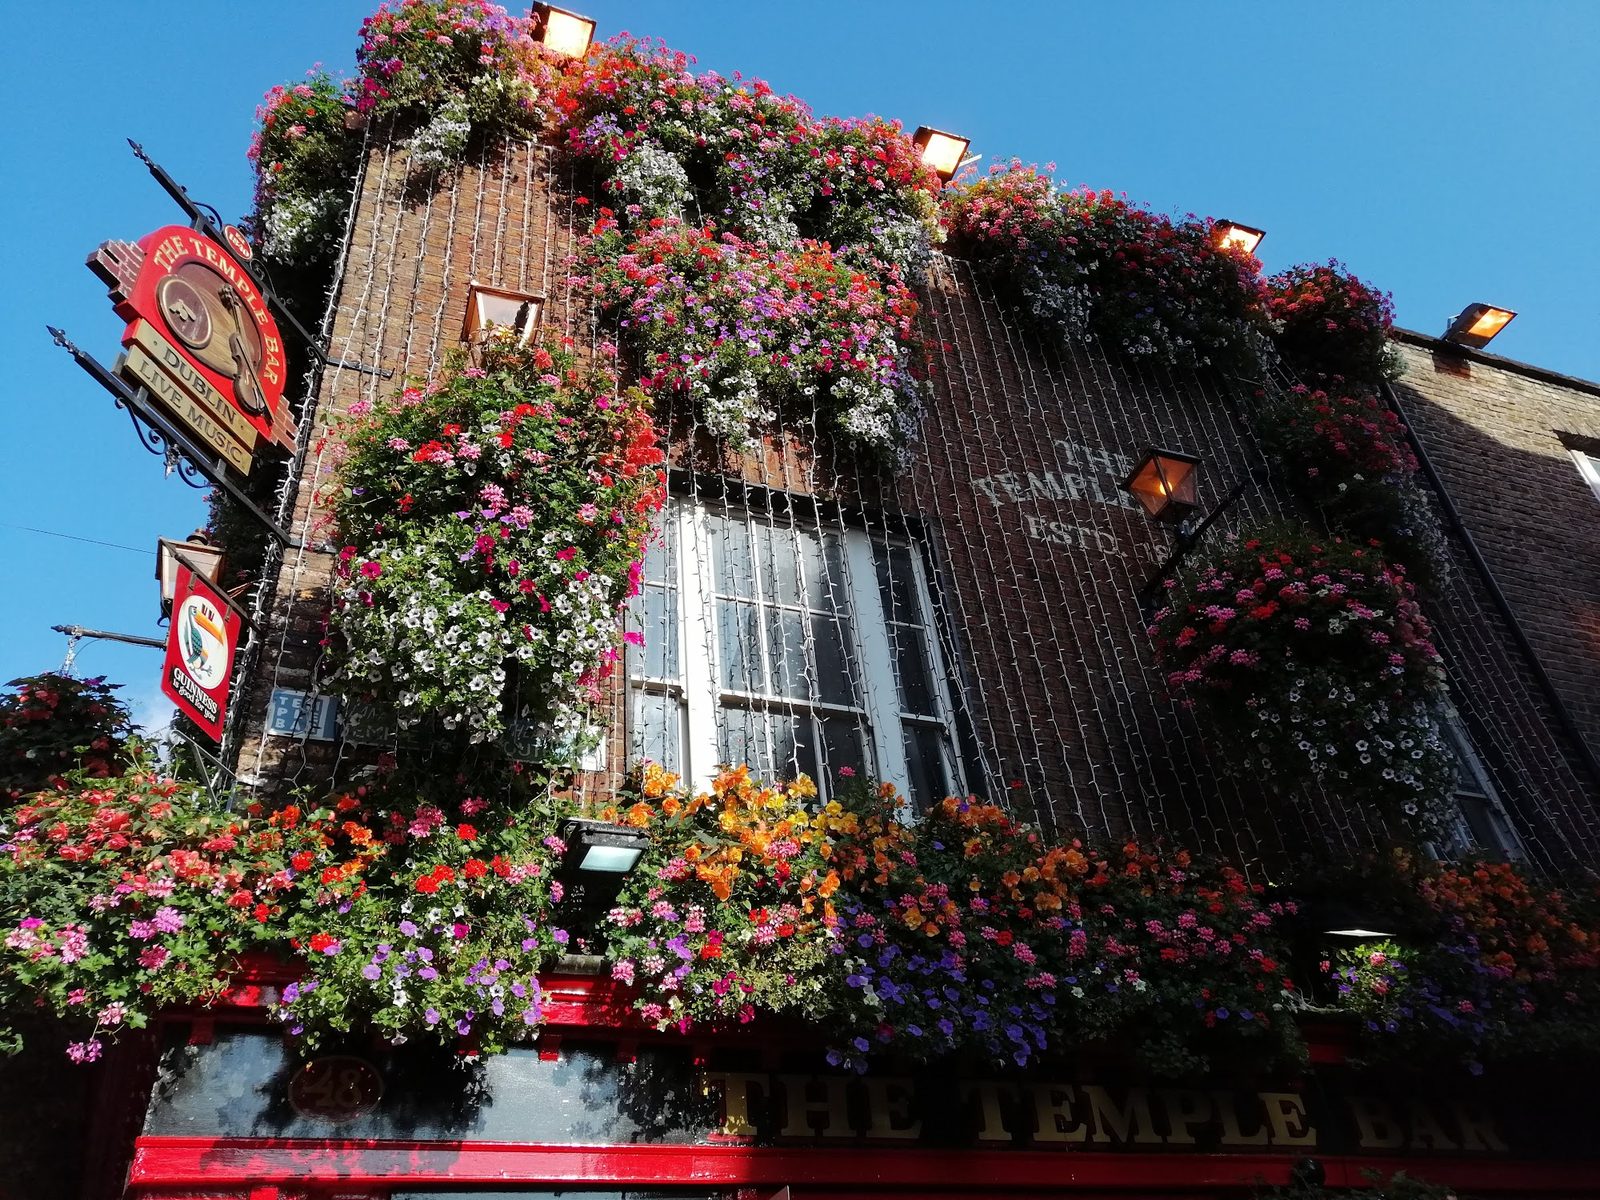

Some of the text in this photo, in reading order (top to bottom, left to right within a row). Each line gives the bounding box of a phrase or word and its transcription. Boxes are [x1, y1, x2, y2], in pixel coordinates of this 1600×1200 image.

[153, 234, 280, 386] THE TEMPLE BAR
[138, 358, 243, 464] LIVE MUSIC
[164, 347, 238, 427] DUBLIN
[173, 667, 218, 714] GUINNESS
[178, 685, 195, 704] good
[194, 698, 205, 712] for
[203, 708, 216, 723] you
[706, 1071, 1509, 1152] THE TEMPLE BAR
